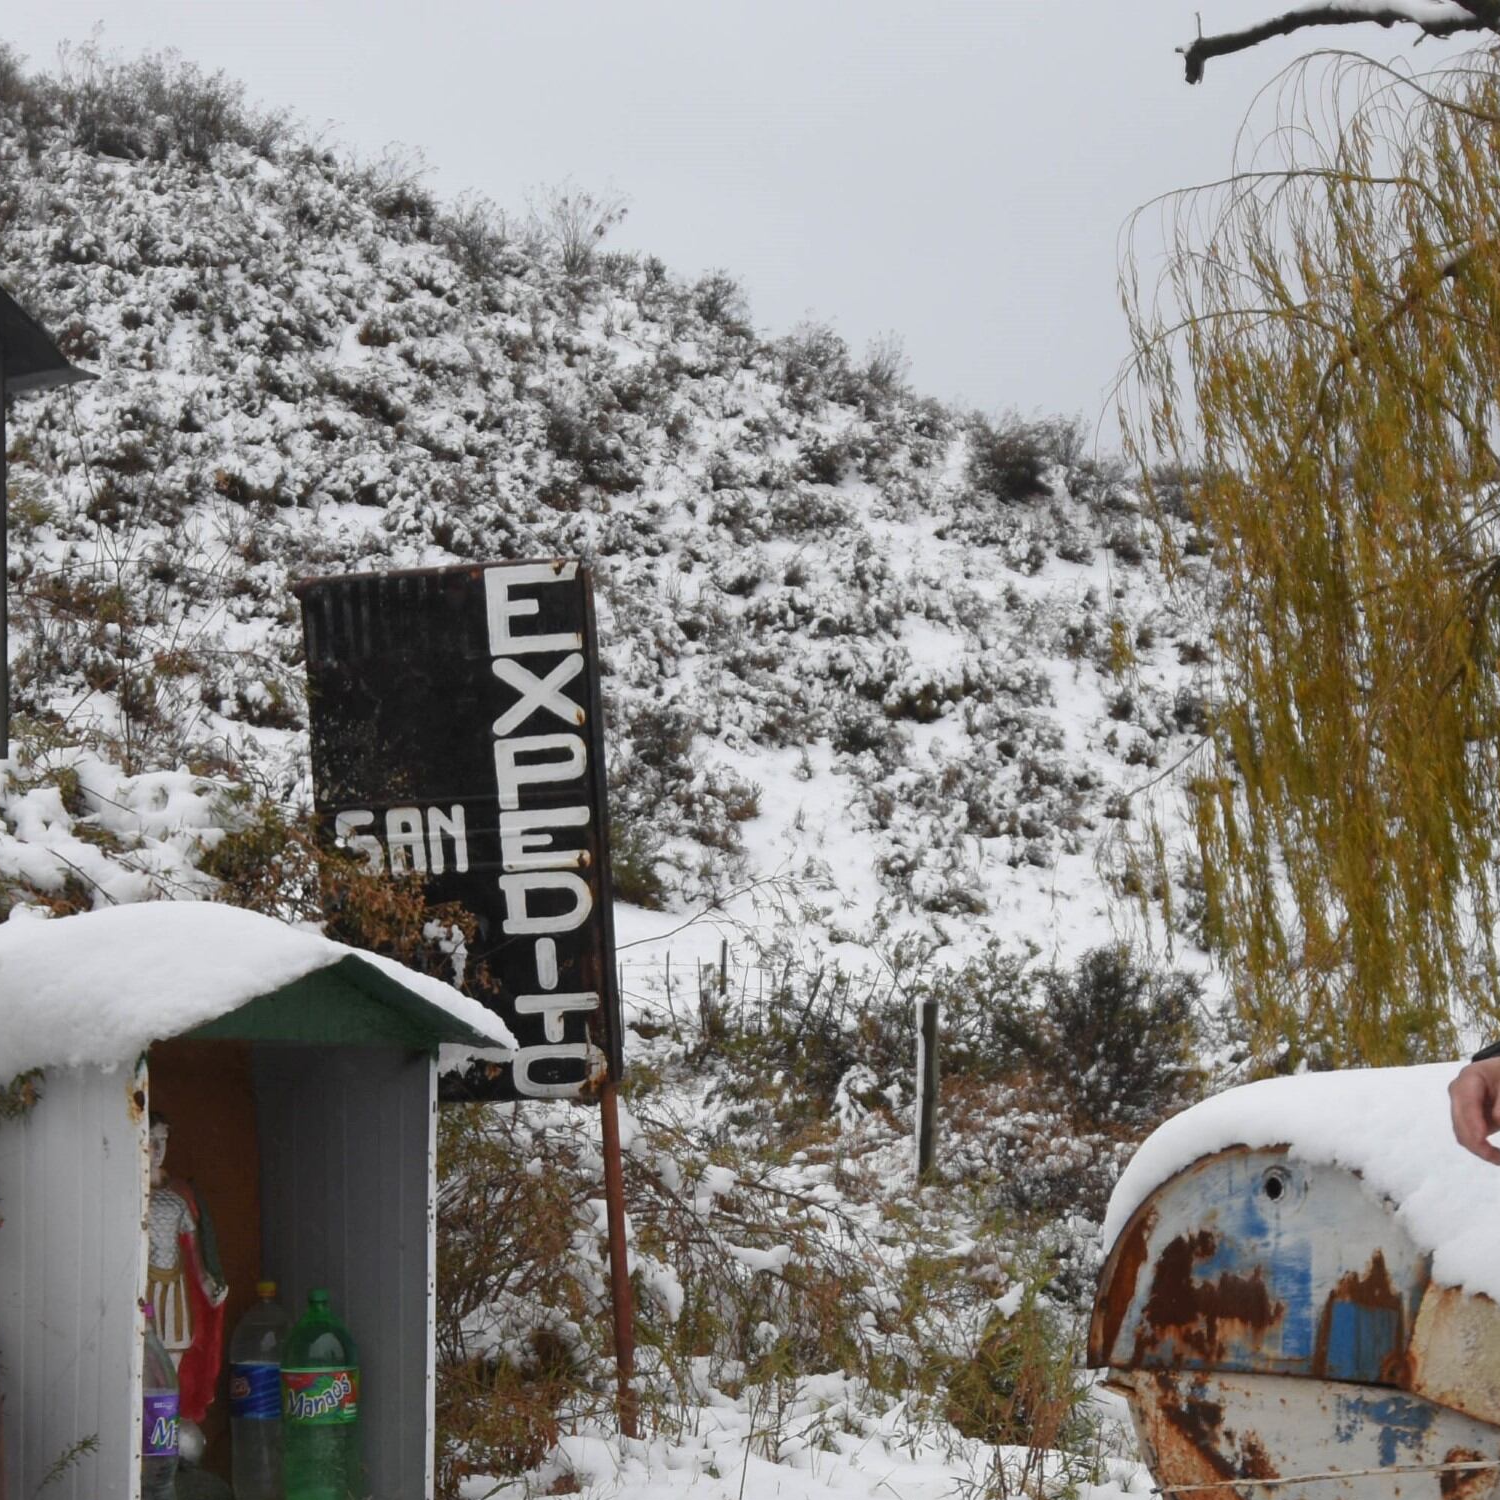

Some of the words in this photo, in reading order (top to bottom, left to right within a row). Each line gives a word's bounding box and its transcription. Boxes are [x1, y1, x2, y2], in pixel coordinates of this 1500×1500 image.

[334, 804, 468, 876] SAN
[484, 560, 607, 1098] EXPEDITO
[287, 1374, 351, 1420] Manaos
